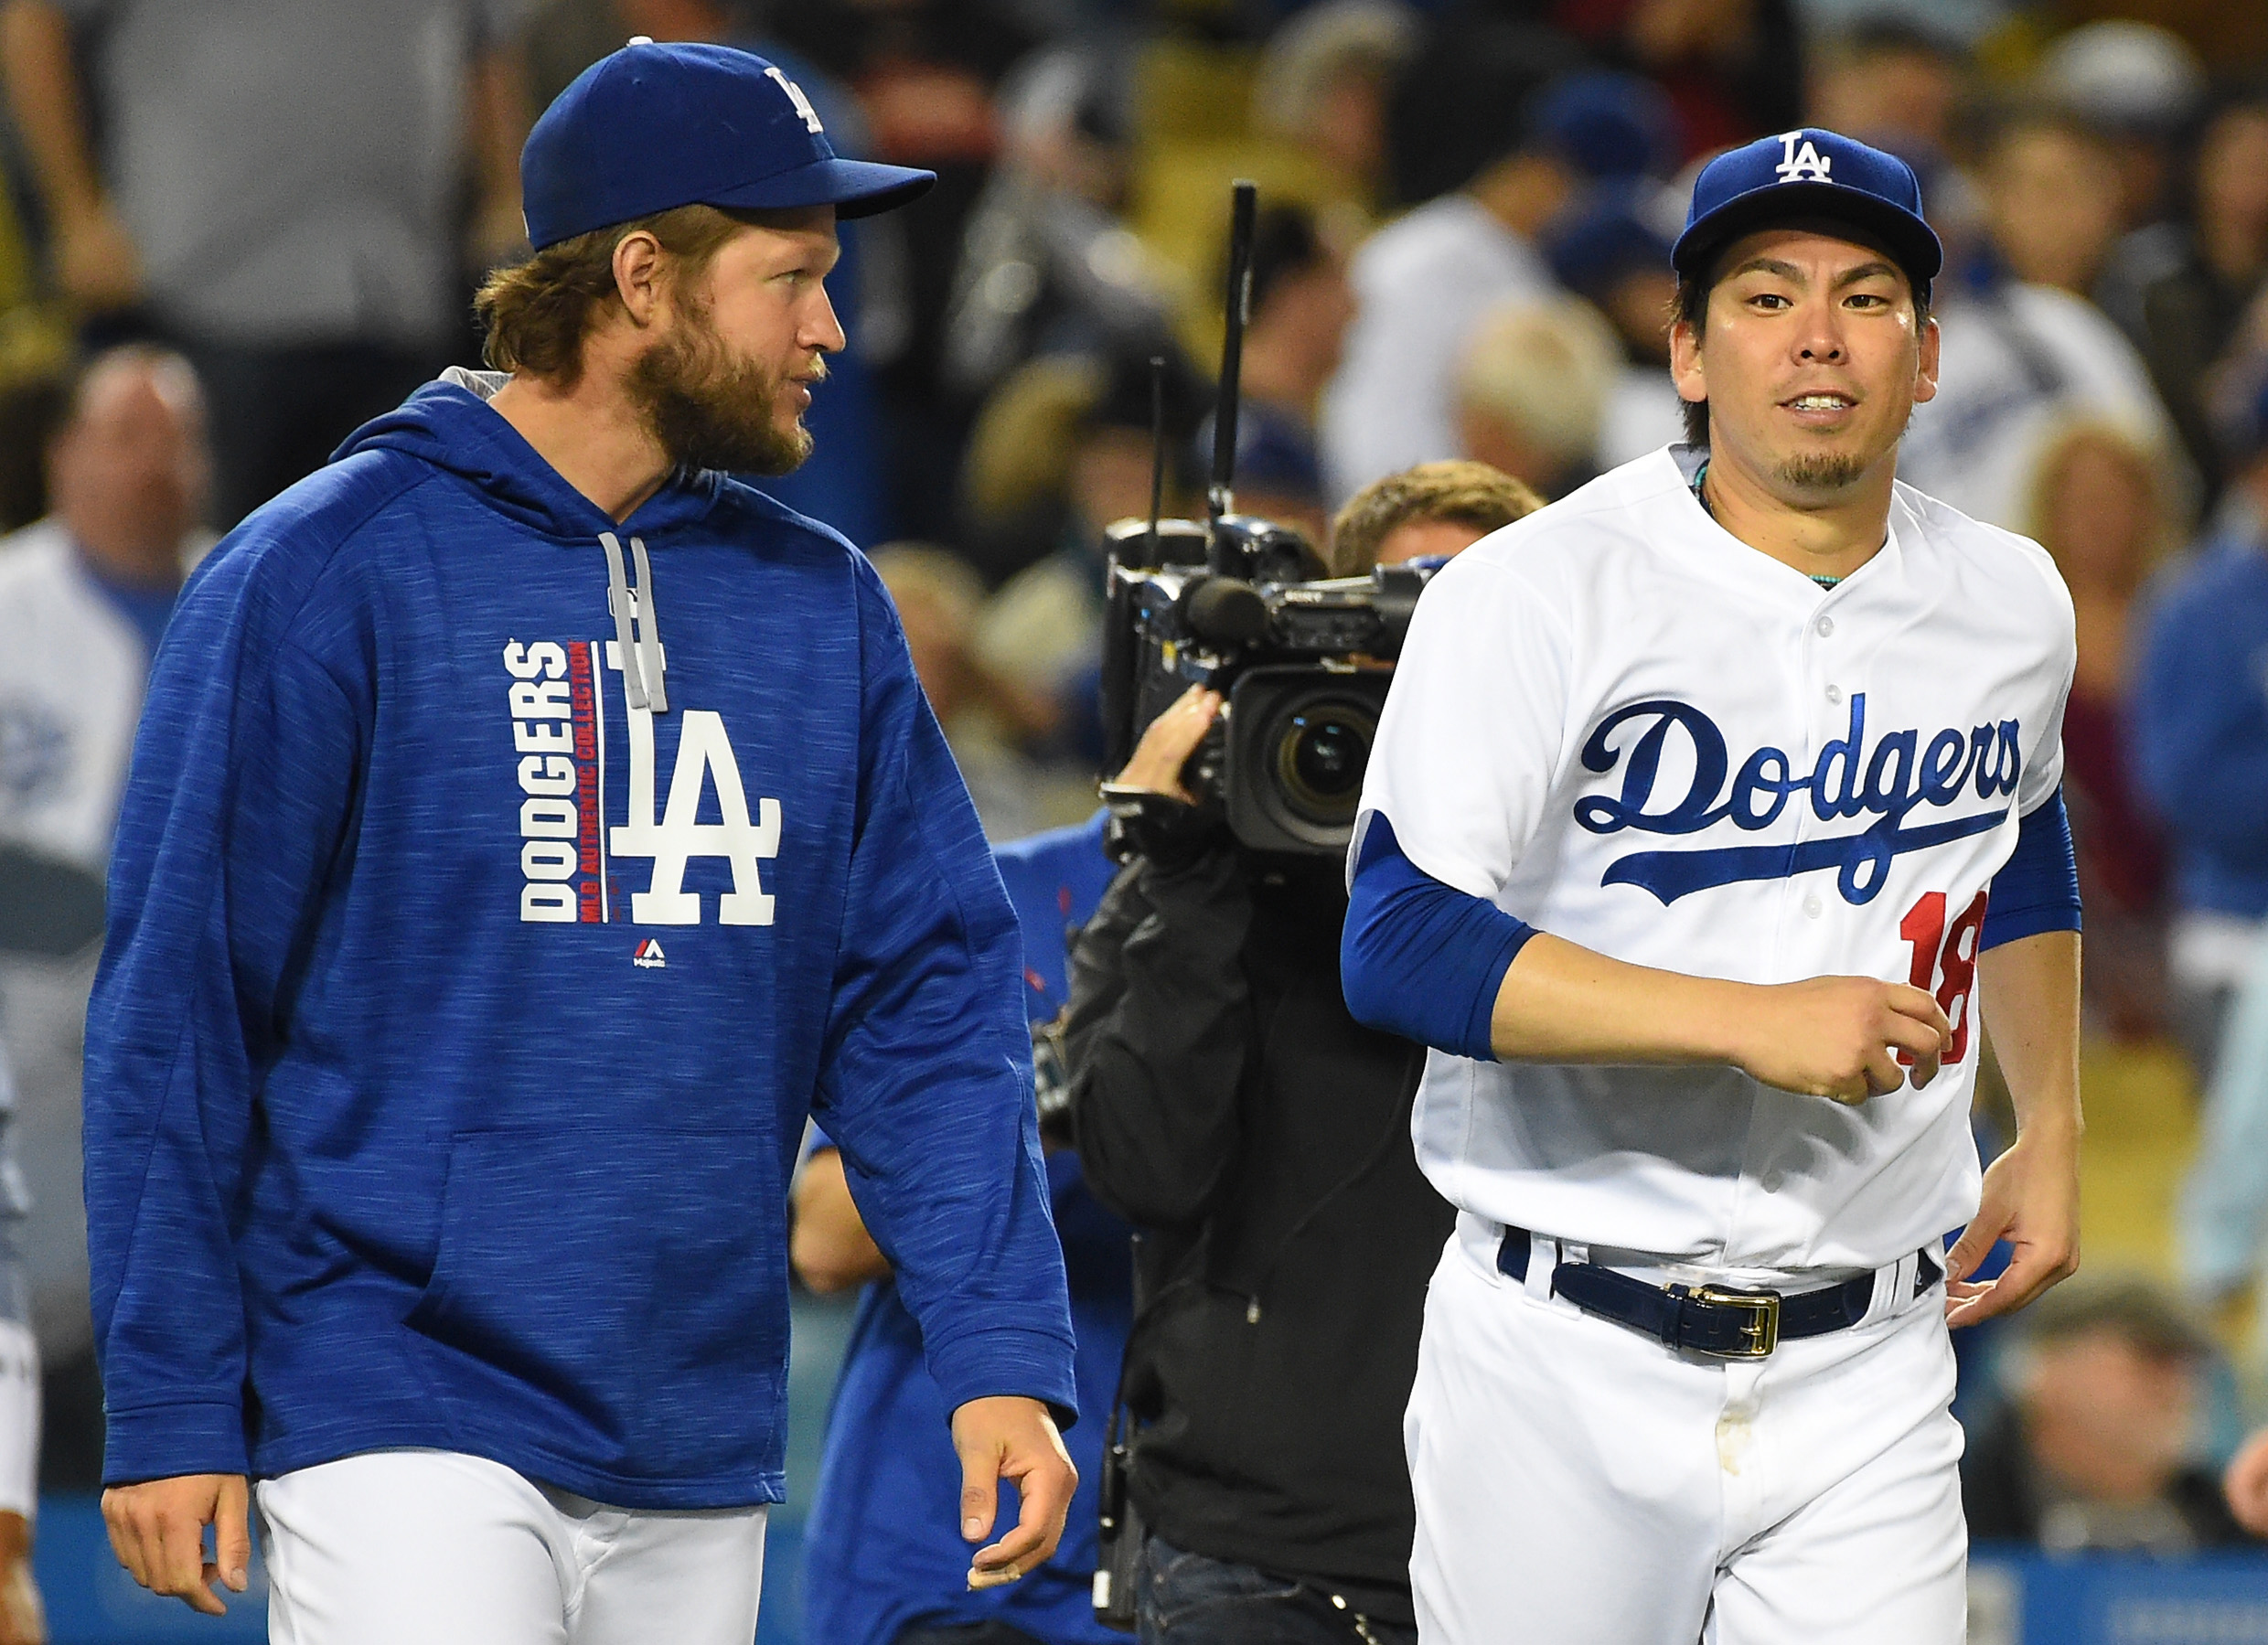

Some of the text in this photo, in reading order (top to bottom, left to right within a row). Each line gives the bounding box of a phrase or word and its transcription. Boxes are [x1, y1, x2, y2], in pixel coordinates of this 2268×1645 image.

[1776, 132, 1832, 183] LA
[503, 638, 577, 923] DODGERS
[568, 641, 600, 924] MLB AUTHENTIC COLLECTION
[605, 641, 781, 925] LA
[1574, 692, 2021, 905] Dodgers
[1899, 891, 1988, 1066] 18
